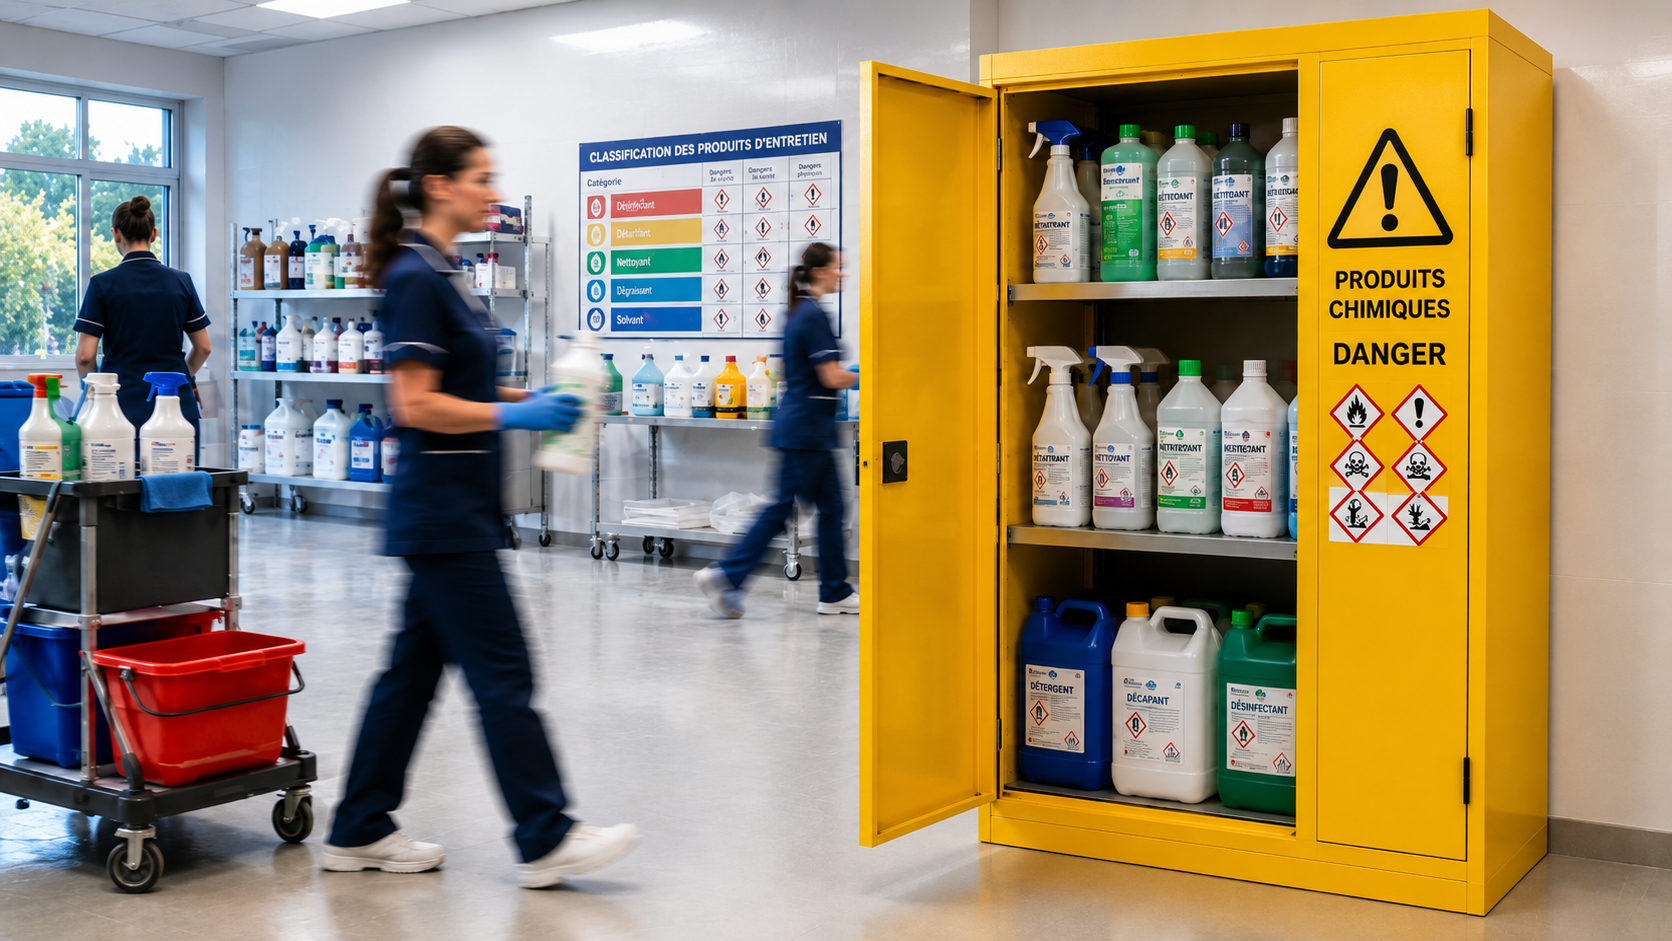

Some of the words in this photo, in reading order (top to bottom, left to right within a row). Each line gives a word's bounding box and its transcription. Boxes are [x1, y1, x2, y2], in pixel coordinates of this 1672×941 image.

[589, 145, 672, 164] CLASSIFICATION
[674, 143, 695, 156] DES
[697, 138, 752, 155] PRODUITS
[754, 132, 828, 150] D'ENTRETIEN
[587, 177, 622, 189] Catégorie
[616, 256, 652, 269] Nettoyant
[1335, 268, 1446, 290] PRODUITS
[1328, 298, 1451, 320] CHIMIQUES
[616, 314, 644, 325] Solvant
[1333, 341, 1447, 366] DANGER
[1030, 680, 1075, 694] DÉTERGENT
[1126, 692, 1170, 706] DÉCAPANT
[1230, 698, 1288, 715] DÉSINFECTANT
